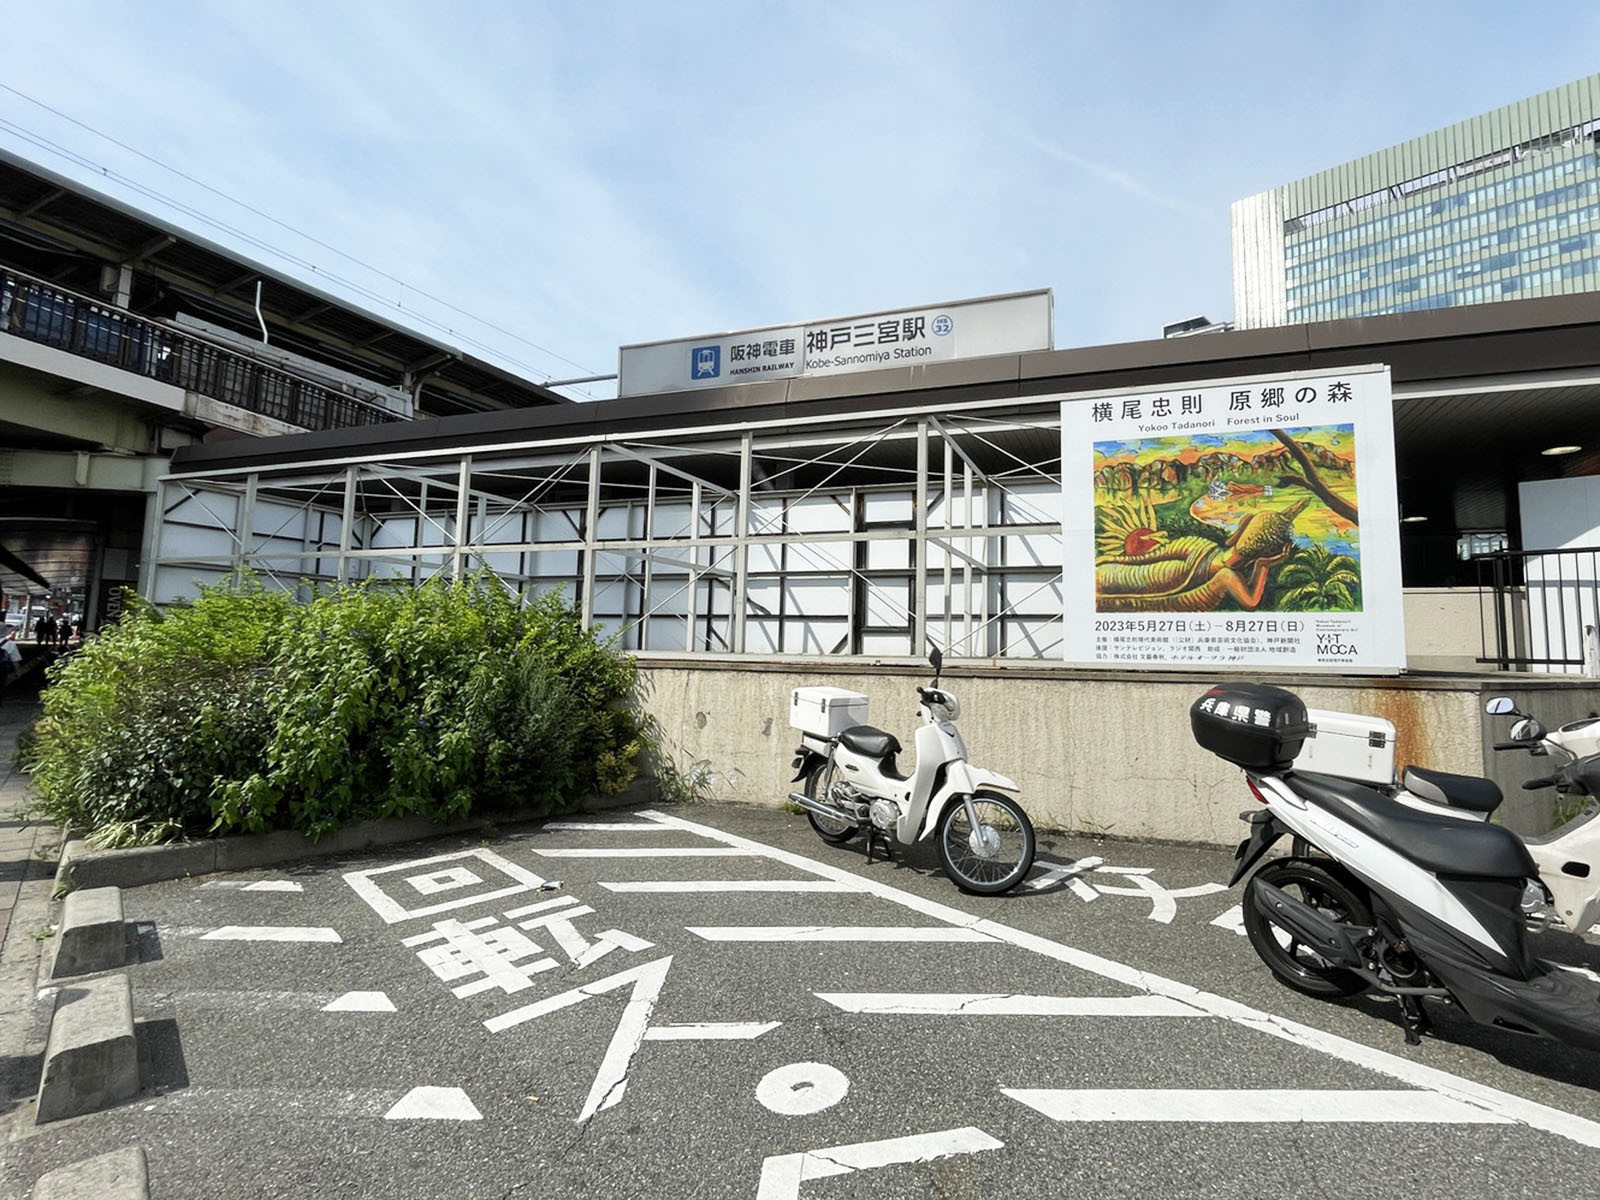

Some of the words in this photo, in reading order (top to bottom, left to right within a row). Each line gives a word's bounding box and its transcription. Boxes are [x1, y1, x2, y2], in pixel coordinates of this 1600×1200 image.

[807, 316, 926, 353] 神戸三宮駅
[935, 325, 949, 333] 32
[730, 339, 796, 362] 阪神電車
[806, 353, 890, 370] Kobe-Sannomiya
[894, 346, 932, 359] Station
[730, 365, 761, 375] HANSHIN
[762, 362, 795, 372] RAILWAY
[1092, 394, 1203, 423] 横尾忠則
[1229, 381, 1353, 411] 原郷の森
[1138, 423, 1168, 432] Yokoo
[1171, 420, 1215, 430] Tadanori
[1227, 416, 1260, 425] Forest
[1263, 415, 1272, 423] in
[1275, 412, 1299, 422] Soul
[1199, 697, 1272, 727] 兵庫県警
